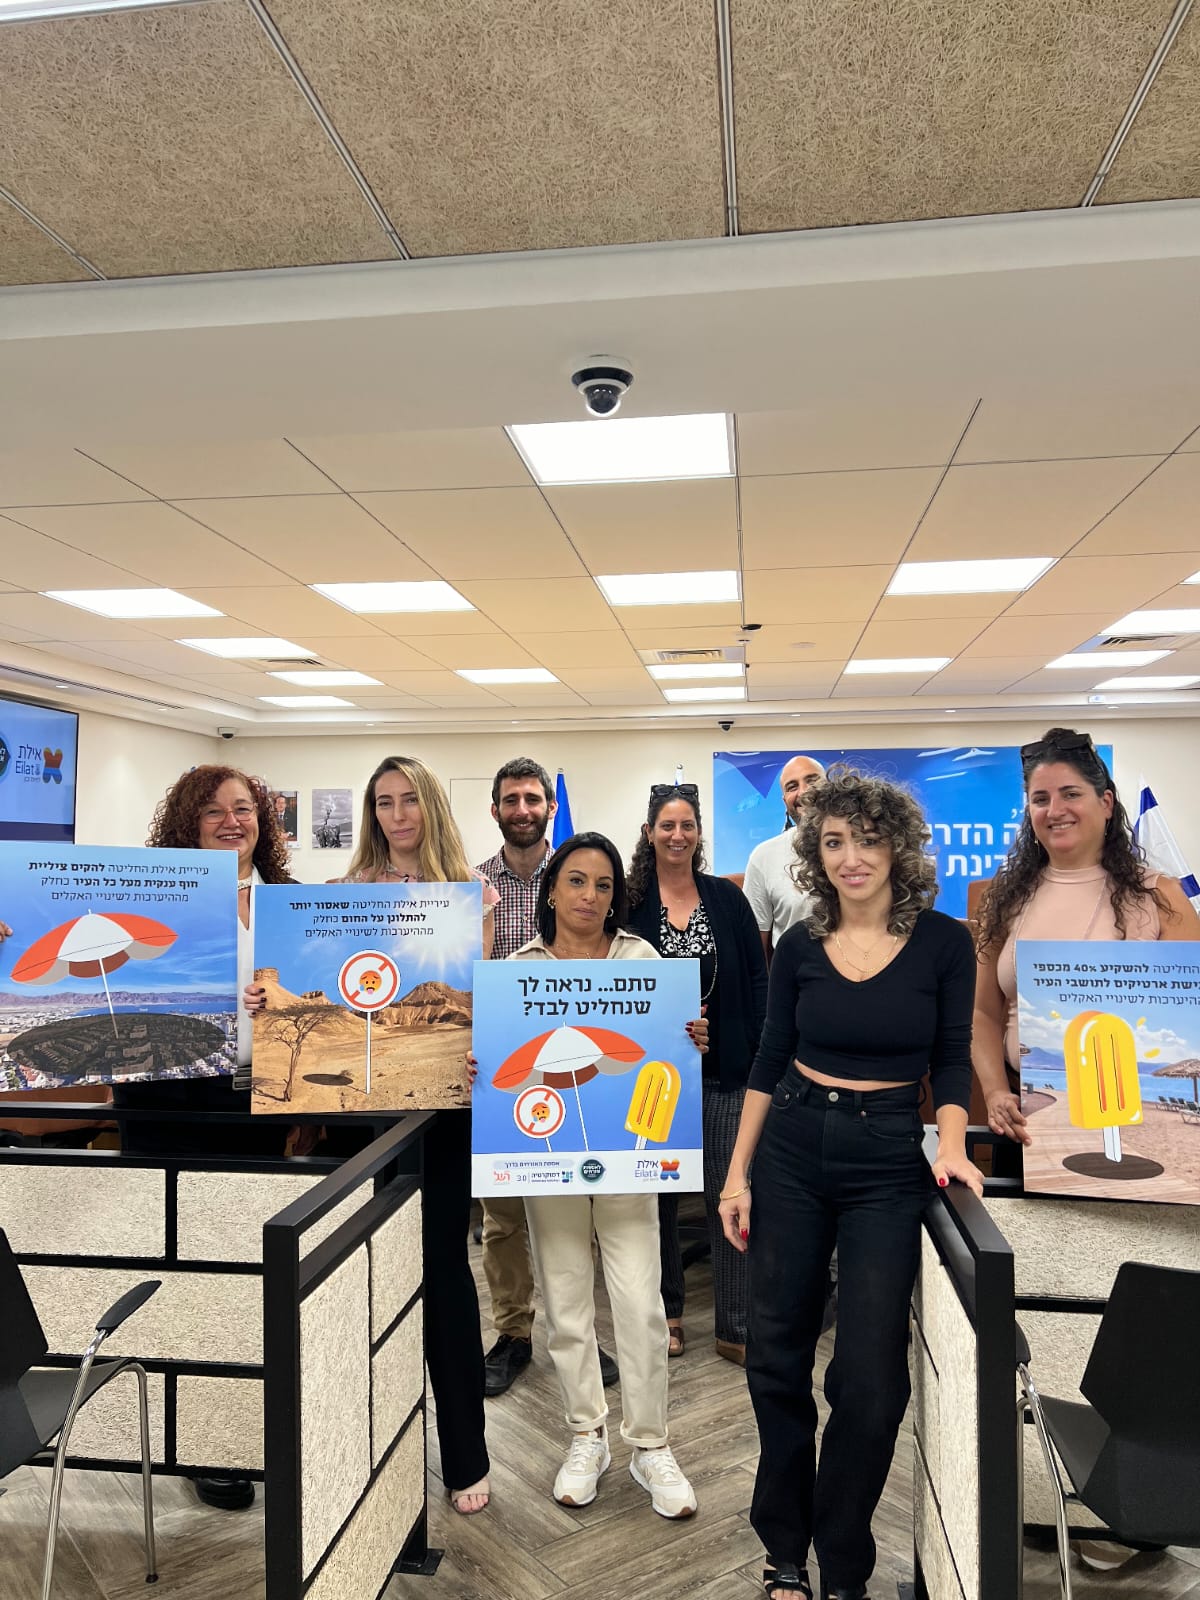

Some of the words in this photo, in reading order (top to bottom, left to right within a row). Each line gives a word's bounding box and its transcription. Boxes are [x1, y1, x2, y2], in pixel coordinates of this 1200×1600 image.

[18, 744, 41, 760] אילת
[16, 761, 34, 775] Eilat
[28, 861, 68, 872] ציליית
[71, 862, 105, 874] להקים
[108, 863, 149, 874] החליטה
[151, 864, 176, 875] אילת
[178, 866, 209, 875] עיריית
[41, 875, 70, 887] כחלק
[72, 877, 101, 887] העיר
[103, 877, 117, 887] כל
[119, 878, 142, 888] מעל
[144, 879, 177, 889] ענקית
[179, 880, 199, 890] חוף
[51, 890, 93, 902] האקלים
[95, 891, 131, 901] לשינויי
[132, 892, 189, 902] מההיערכות
[289, 902, 312, 911] יותר
[314, 901, 350, 911] שאסור
[352, 899, 391, 910] החליטה
[393, 899, 418, 909] אילת
[419, 900, 450, 909] עיריית
[313, 914, 339, 926] כחלק
[341, 914, 368, 924] החום
[370, 912, 385, 923] על
[386, 913, 427, 925] להתלונן
[305, 928, 343, 939] האקלים
[345, 926, 379, 937] לשינויי
[380, 927, 434, 937] מההיערכות
[1033, 963, 1071, 973] מכספי
[1073, 963, 1098, 973] 40%
[1100, 963, 1150, 976] להשקיע
[518, 976, 540, 997] לך
[545, 977, 592, 993] נראה
[598, 977, 657, 992] סתם...
[1033, 978, 1063, 988] העיר
[1065, 977, 1111, 988] לתושבי
[1113, 979, 1168, 991] ארטיקים
[1058, 993, 1103, 1004] האקלים
[1105, 994, 1146, 1005] לשינויי
[523, 998, 570, 1016] לבד?
[575, 998, 652, 1016] שנחליט
[636, 1159, 659, 1169] אילת
[634, 1169, 653, 1178] Eilat
